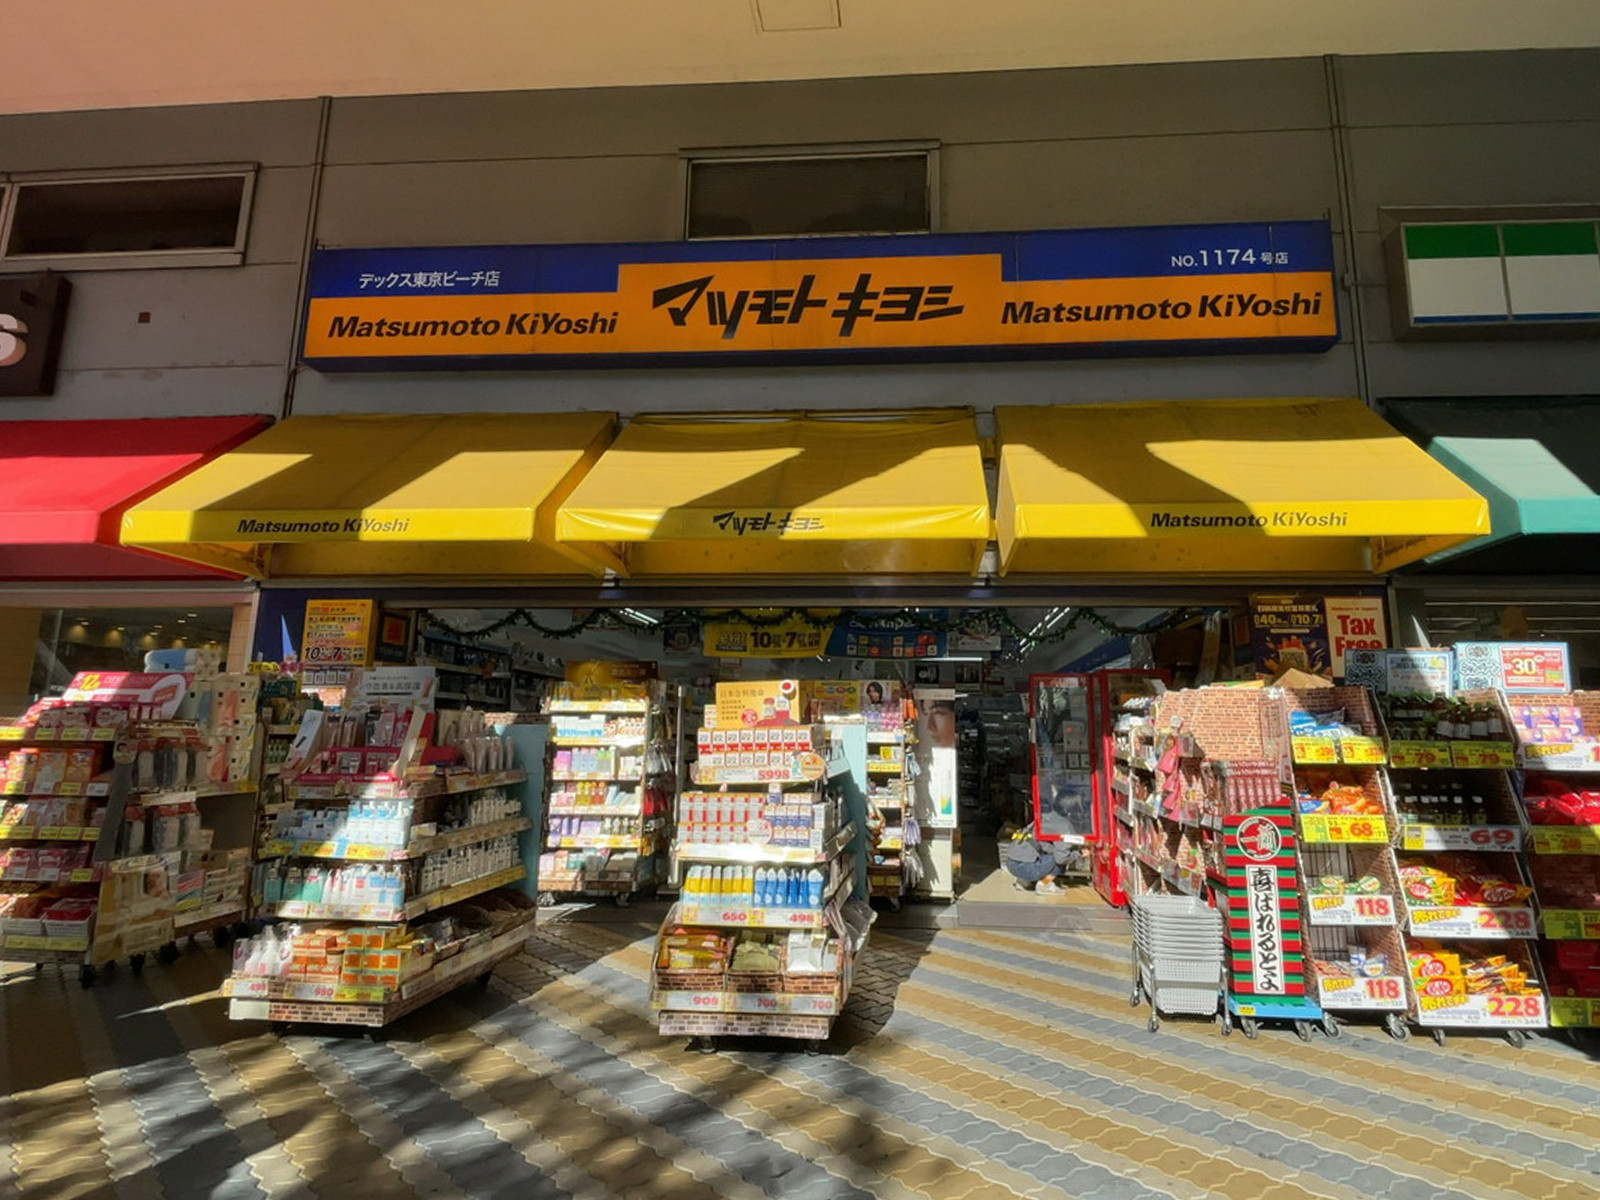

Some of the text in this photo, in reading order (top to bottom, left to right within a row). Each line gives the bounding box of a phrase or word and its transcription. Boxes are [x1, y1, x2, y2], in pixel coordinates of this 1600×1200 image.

[359, 270, 501, 289] デックス東京ビーチ店
[653, 273, 964, 339] マツモトキヨシ
[1001, 292, 1322, 325] Matsumoto KiYoshi
[328, 311, 618, 338] Matsumoto KiYoshi
[237, 516, 410, 534] Matsumoto KiYoshi
[713, 510, 826, 536] マツモトキヨシ
[1151, 511, 1348, 529] Matsumoto KiYoshi
[1337, 615, 1376, 636] Tax
[1334, 636, 1383, 657] Free
[1350, 822, 1374, 837] 68
[1471, 829, 1515, 845] 69
[722, 912, 747, 921] 650
[1356, 898, 1389, 916] 118
[1478, 910, 1532, 929] 228
[1366, 979, 1400, 999] 118
[1487, 996, 1540, 1017] 228
